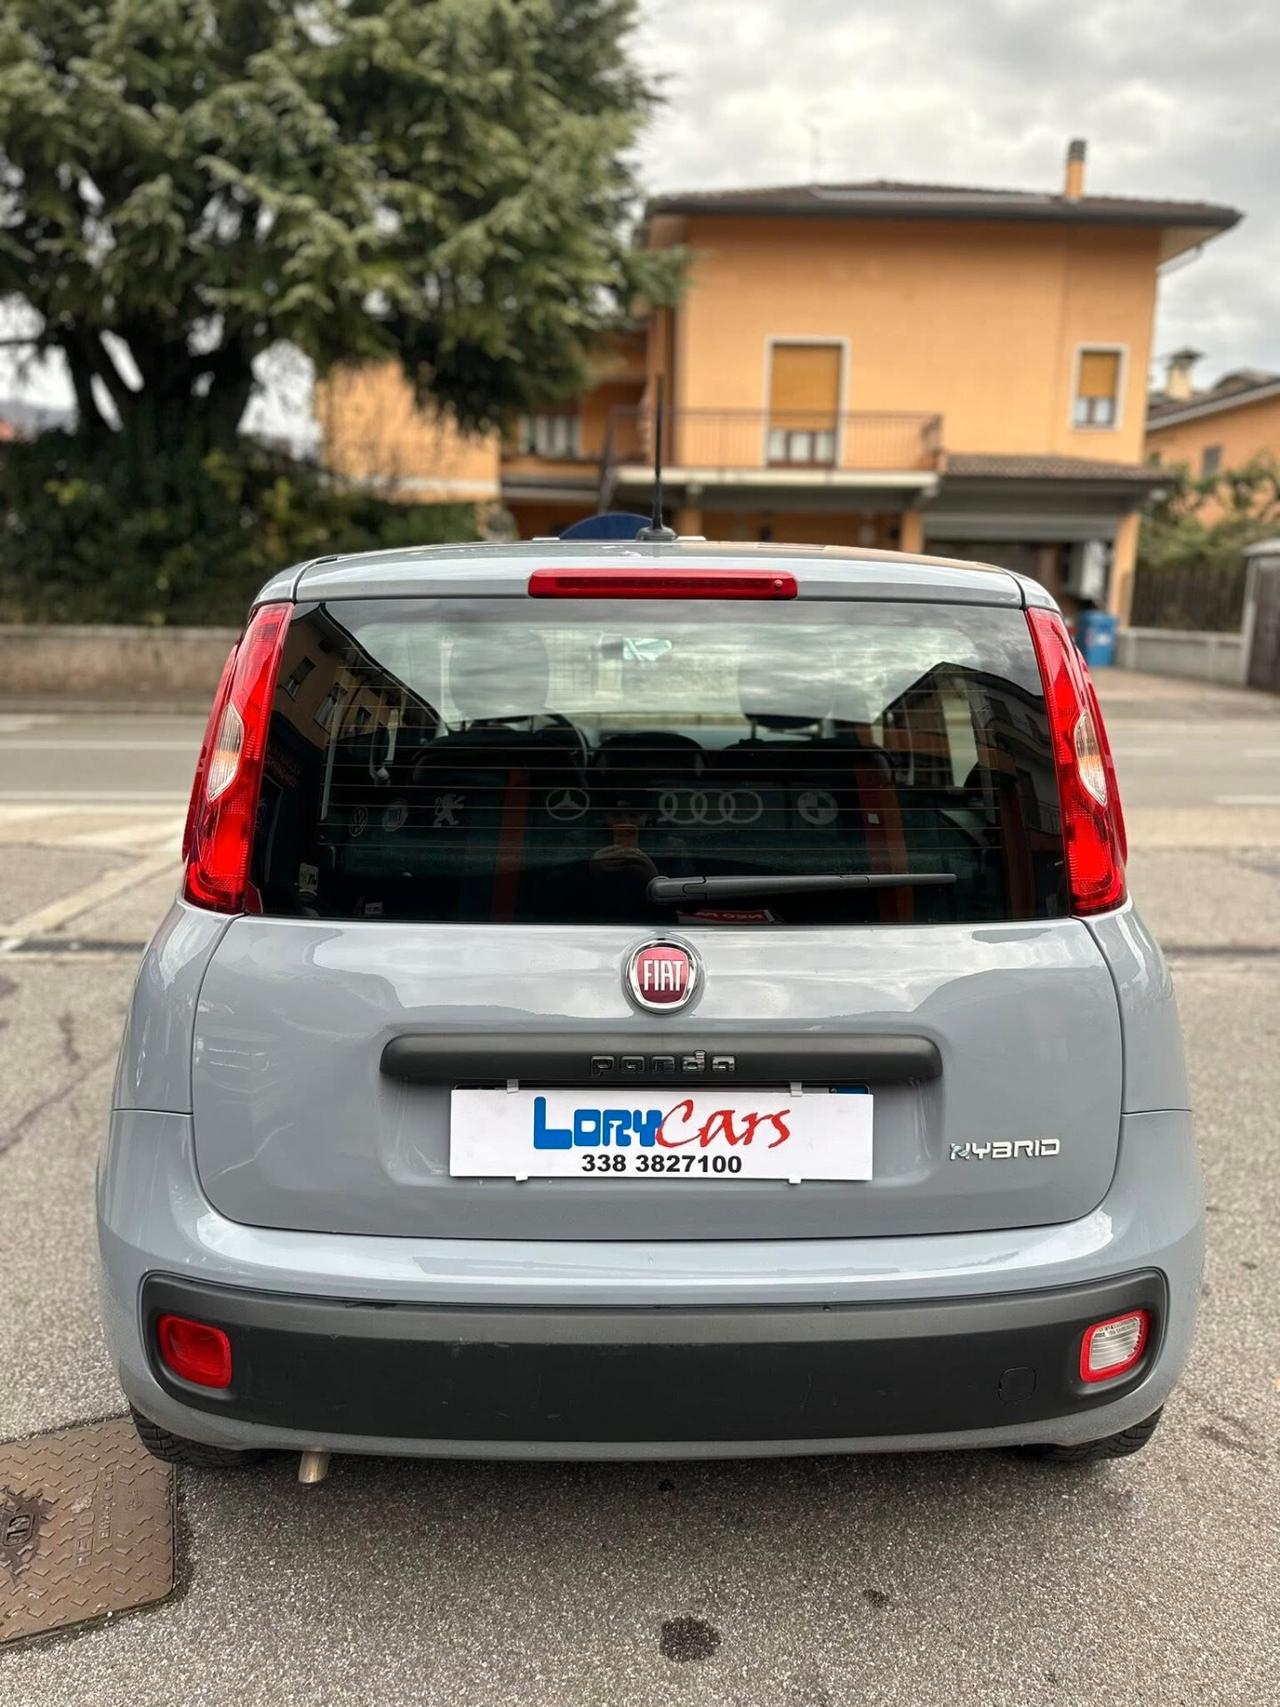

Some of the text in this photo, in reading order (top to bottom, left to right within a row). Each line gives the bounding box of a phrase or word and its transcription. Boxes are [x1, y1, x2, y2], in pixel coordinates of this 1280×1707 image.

[643, 959, 685, 992] FIAT
[950, 1138, 1060, 1160] HYBRID
[581, 1153, 743, 1174] 338 3827100
